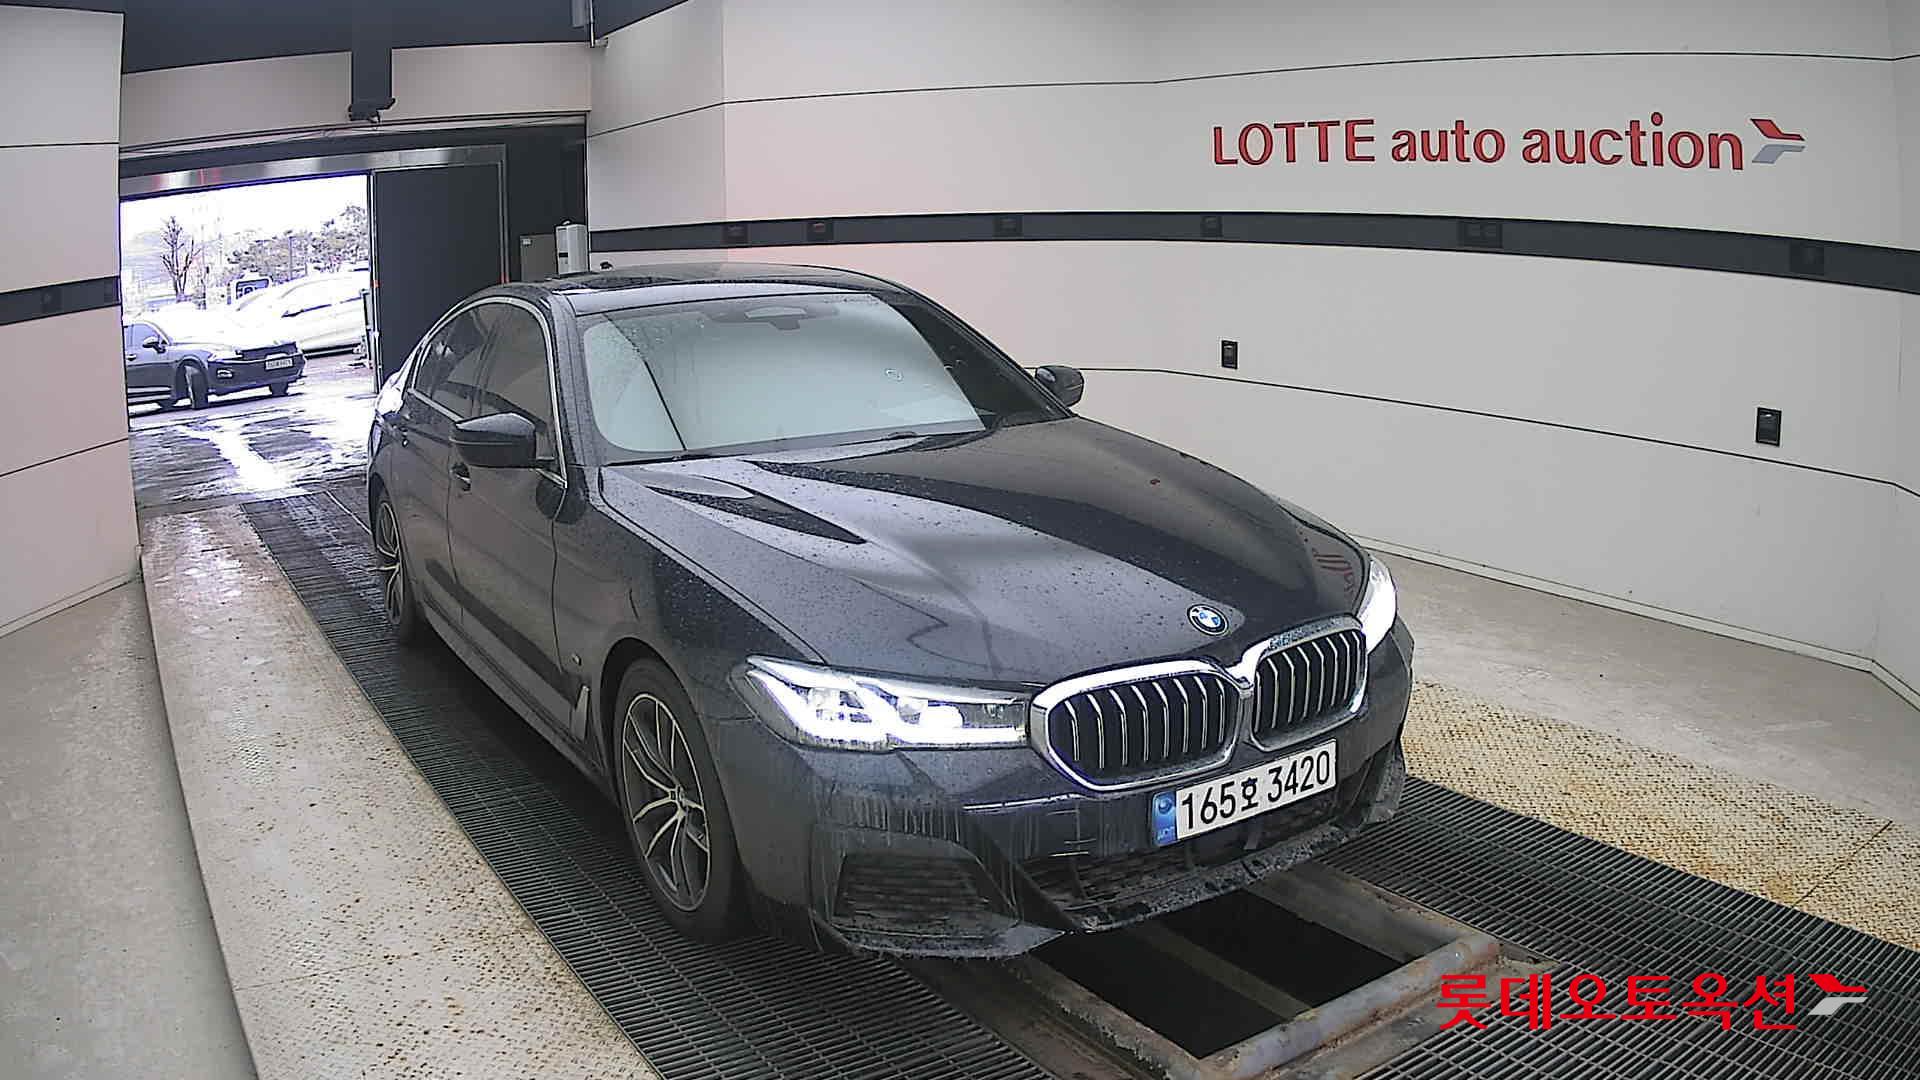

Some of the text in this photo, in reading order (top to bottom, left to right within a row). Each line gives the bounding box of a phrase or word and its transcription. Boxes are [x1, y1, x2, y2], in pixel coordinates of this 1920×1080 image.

[1213, 111, 1744, 171] LOTTE auto auction
[1181, 750, 1331, 830] 165호 3420
